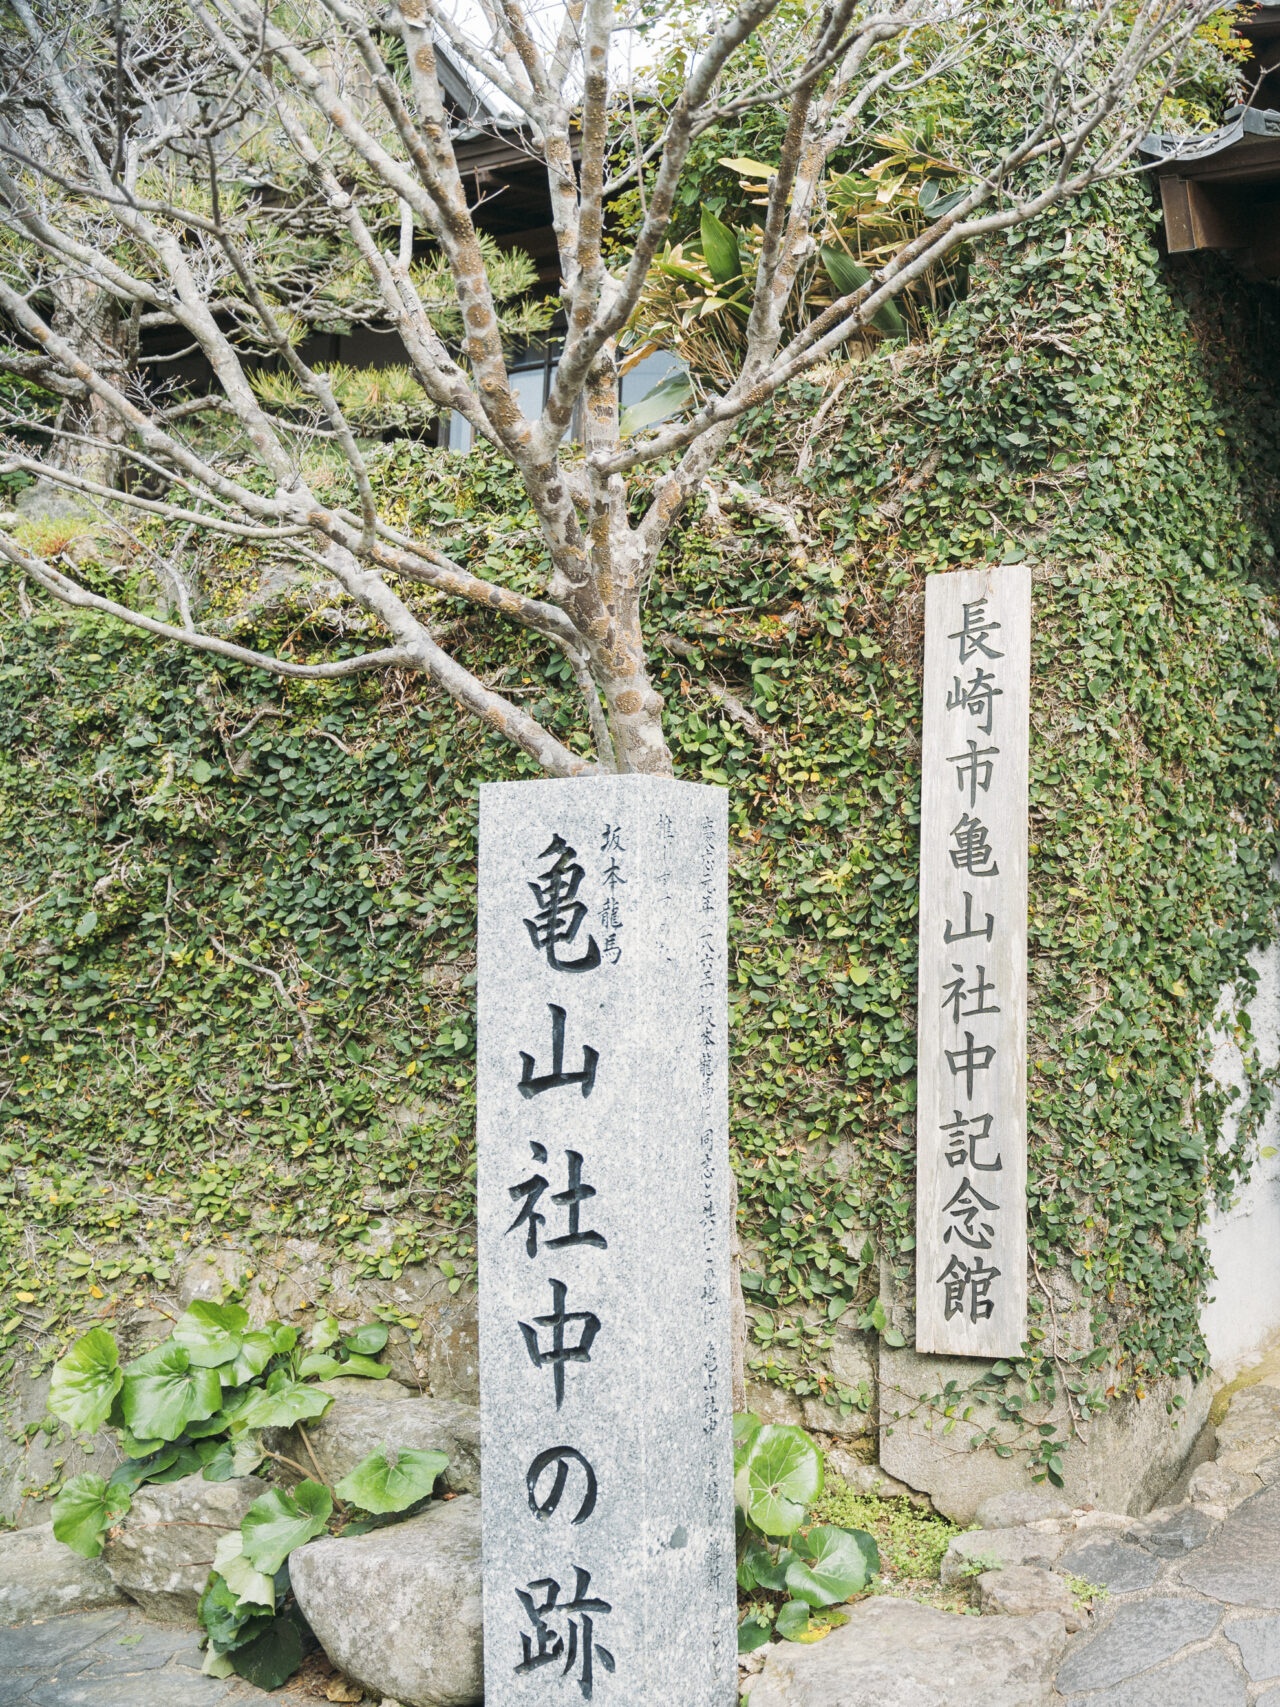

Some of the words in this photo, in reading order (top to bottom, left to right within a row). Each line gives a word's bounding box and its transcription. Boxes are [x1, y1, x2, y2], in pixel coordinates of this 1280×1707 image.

[597, 822, 628, 966] 坂本龍馬
[935, 597, 1005, 1325] 長崎市亀山社中記念館
[503, 832, 617, 1701] 亀山社中の跡
